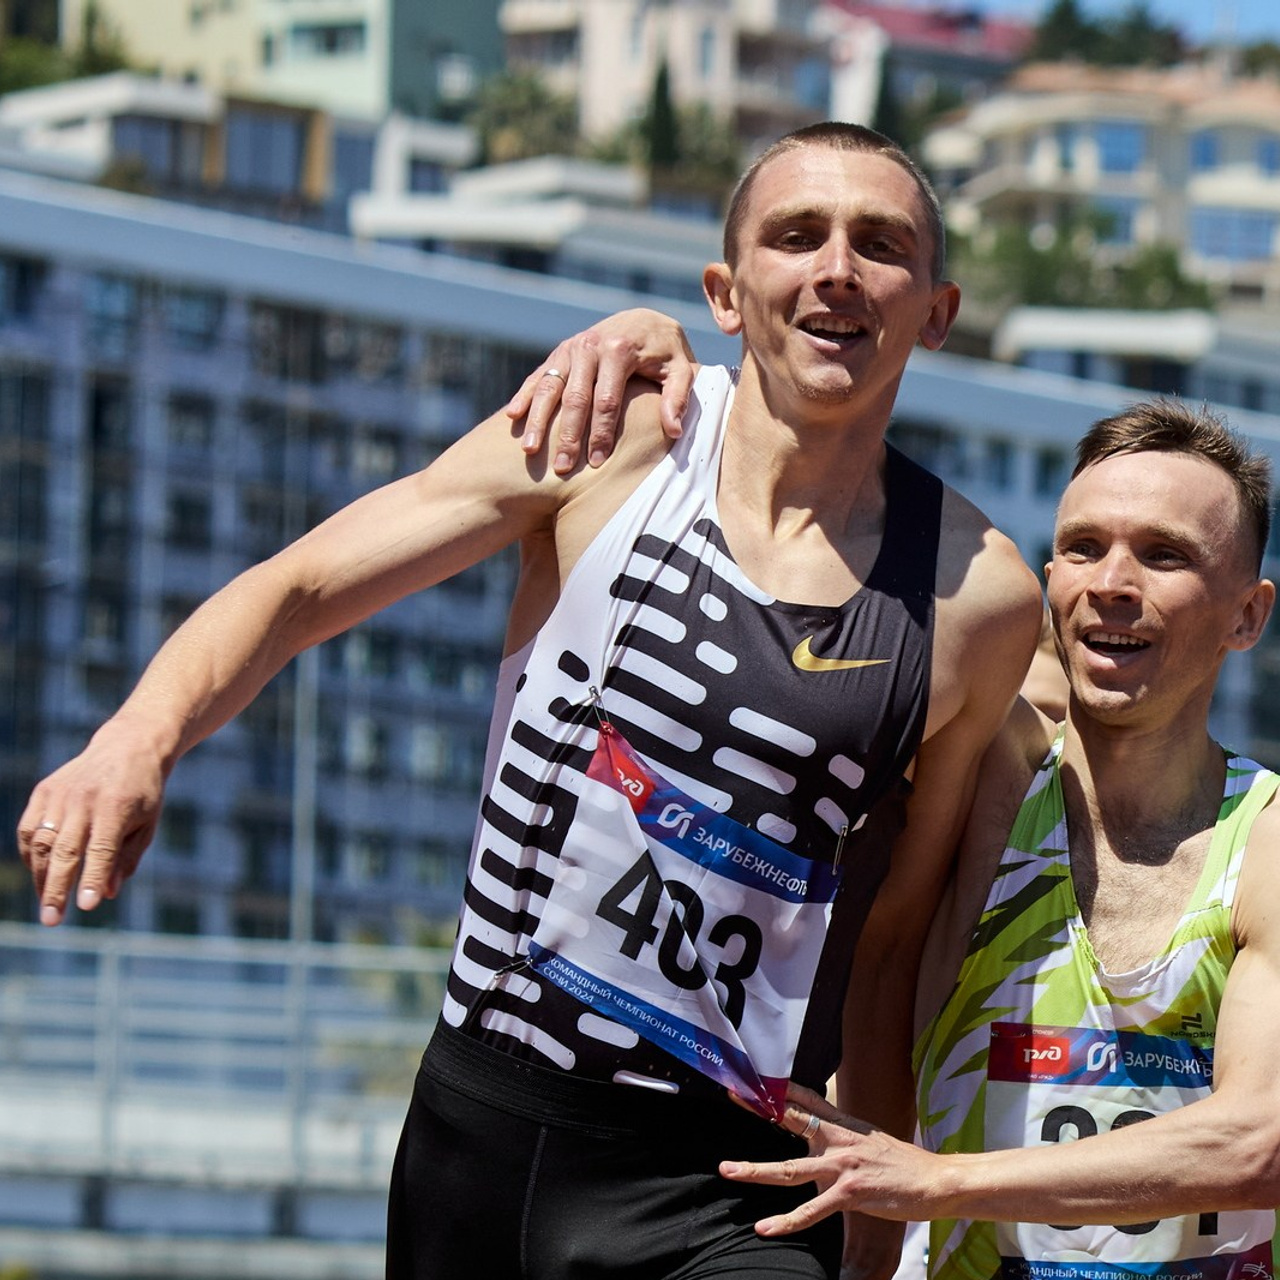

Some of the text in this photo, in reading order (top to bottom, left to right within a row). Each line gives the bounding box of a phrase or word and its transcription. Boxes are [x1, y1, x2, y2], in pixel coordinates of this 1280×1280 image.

[595, 848, 763, 1032] 403
[543, 966, 594, 1004] СОЧИ 2024
[613, 996, 679, 1038] ЧЕМПИОНАТ
[679, 1034, 724, 1067] РОССИИ
